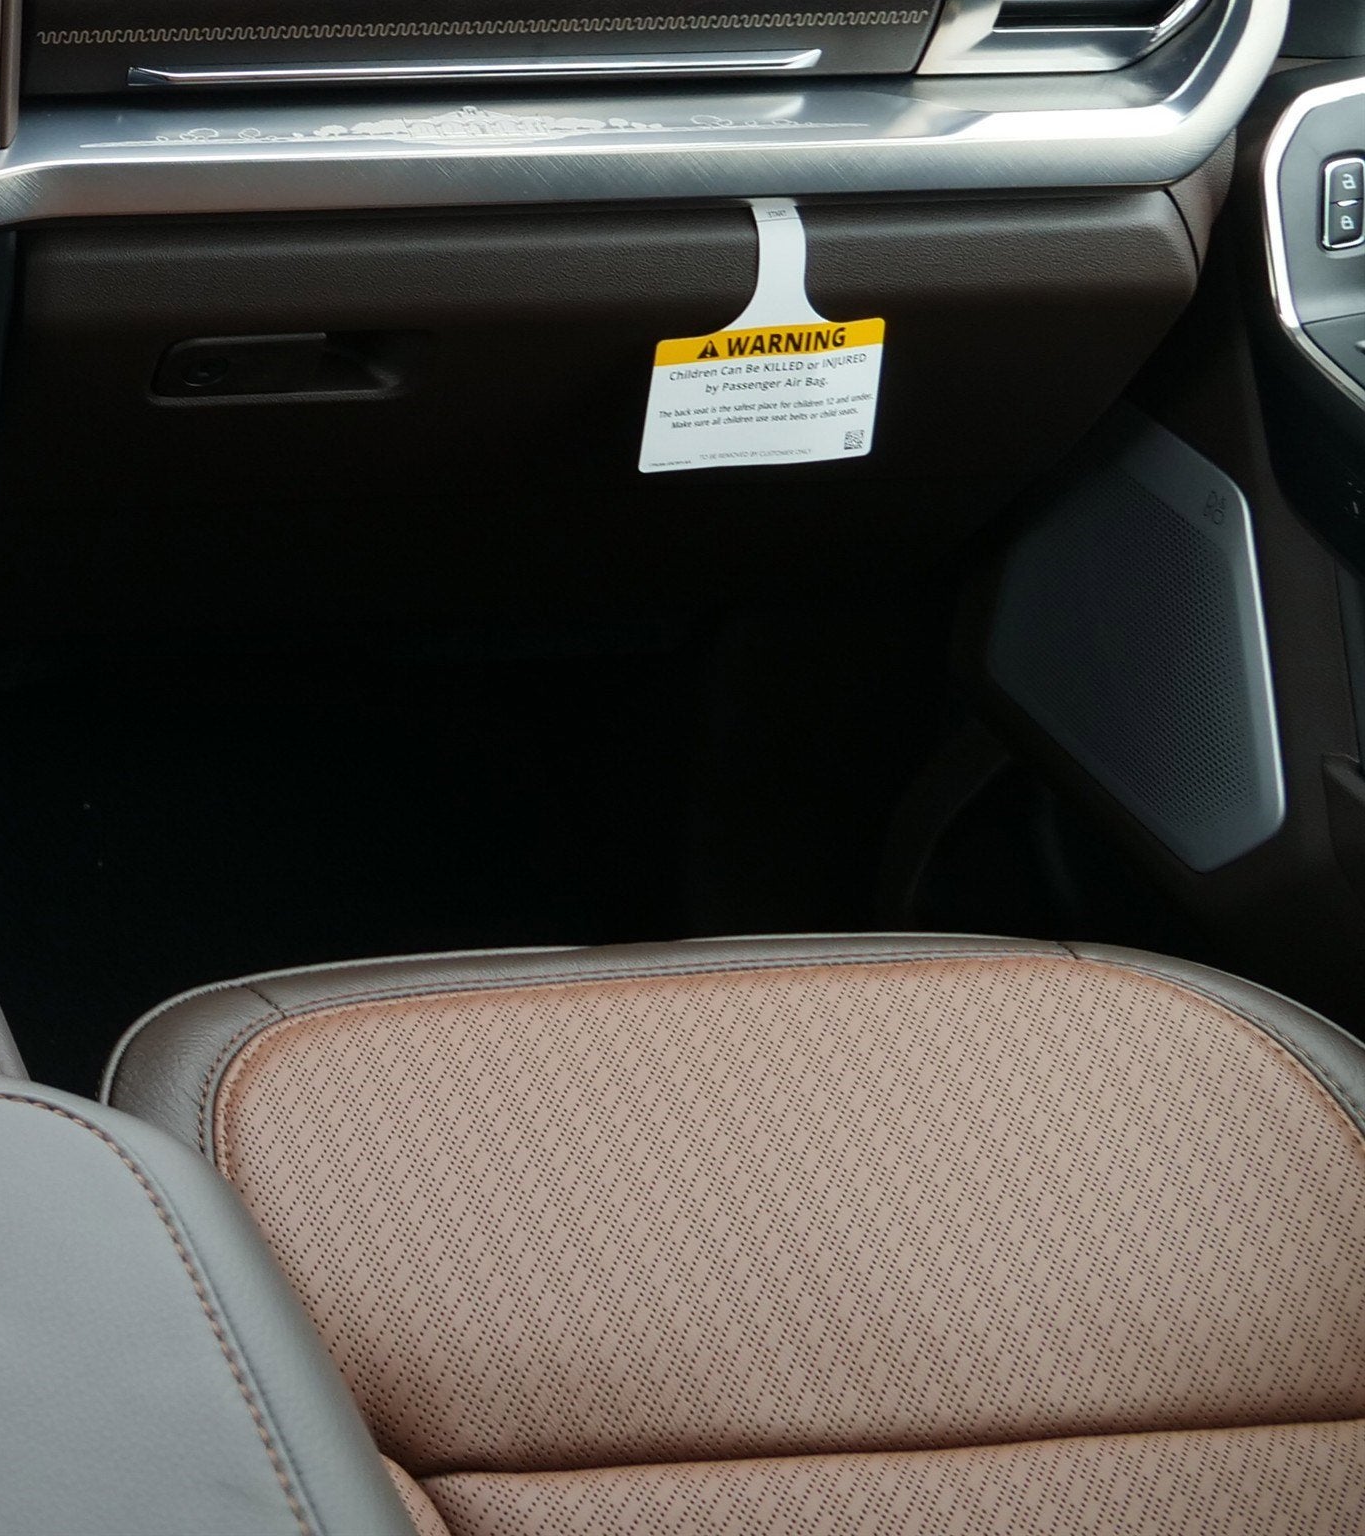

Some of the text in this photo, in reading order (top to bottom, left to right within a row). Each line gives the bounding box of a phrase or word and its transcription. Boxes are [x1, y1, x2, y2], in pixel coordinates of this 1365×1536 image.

[727, 327, 847, 357] WARNING
[669, 353, 867, 381] Children Can Be KILLED or INJURED
[704, 376, 829, 395] by Passenger Air Bag.
